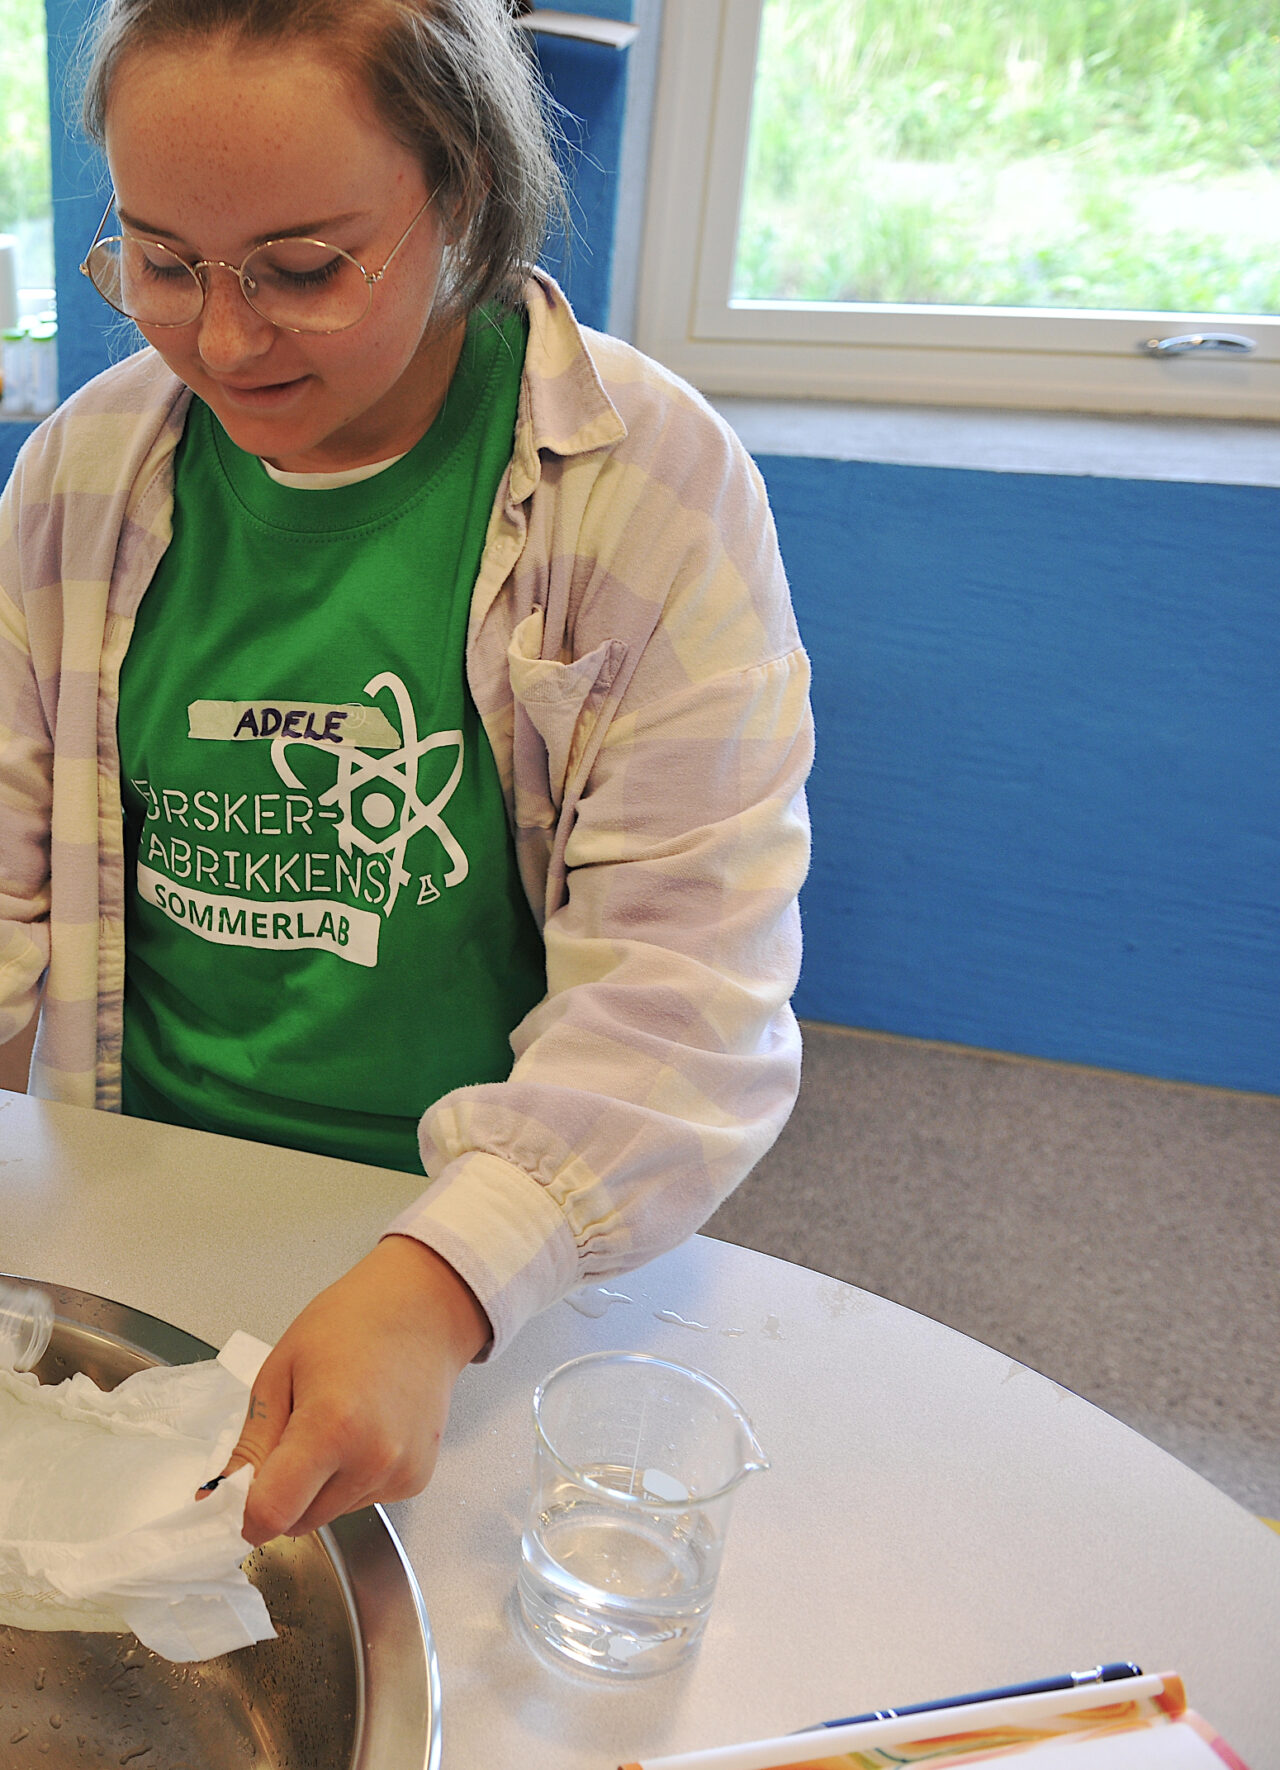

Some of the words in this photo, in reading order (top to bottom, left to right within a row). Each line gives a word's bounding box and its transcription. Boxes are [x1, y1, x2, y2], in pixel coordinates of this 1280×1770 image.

[232, 706, 349, 744] ADELE
[141, 828, 387, 904] ABRIKKENS
[153, 883, 351, 947] SOMMERLAB
